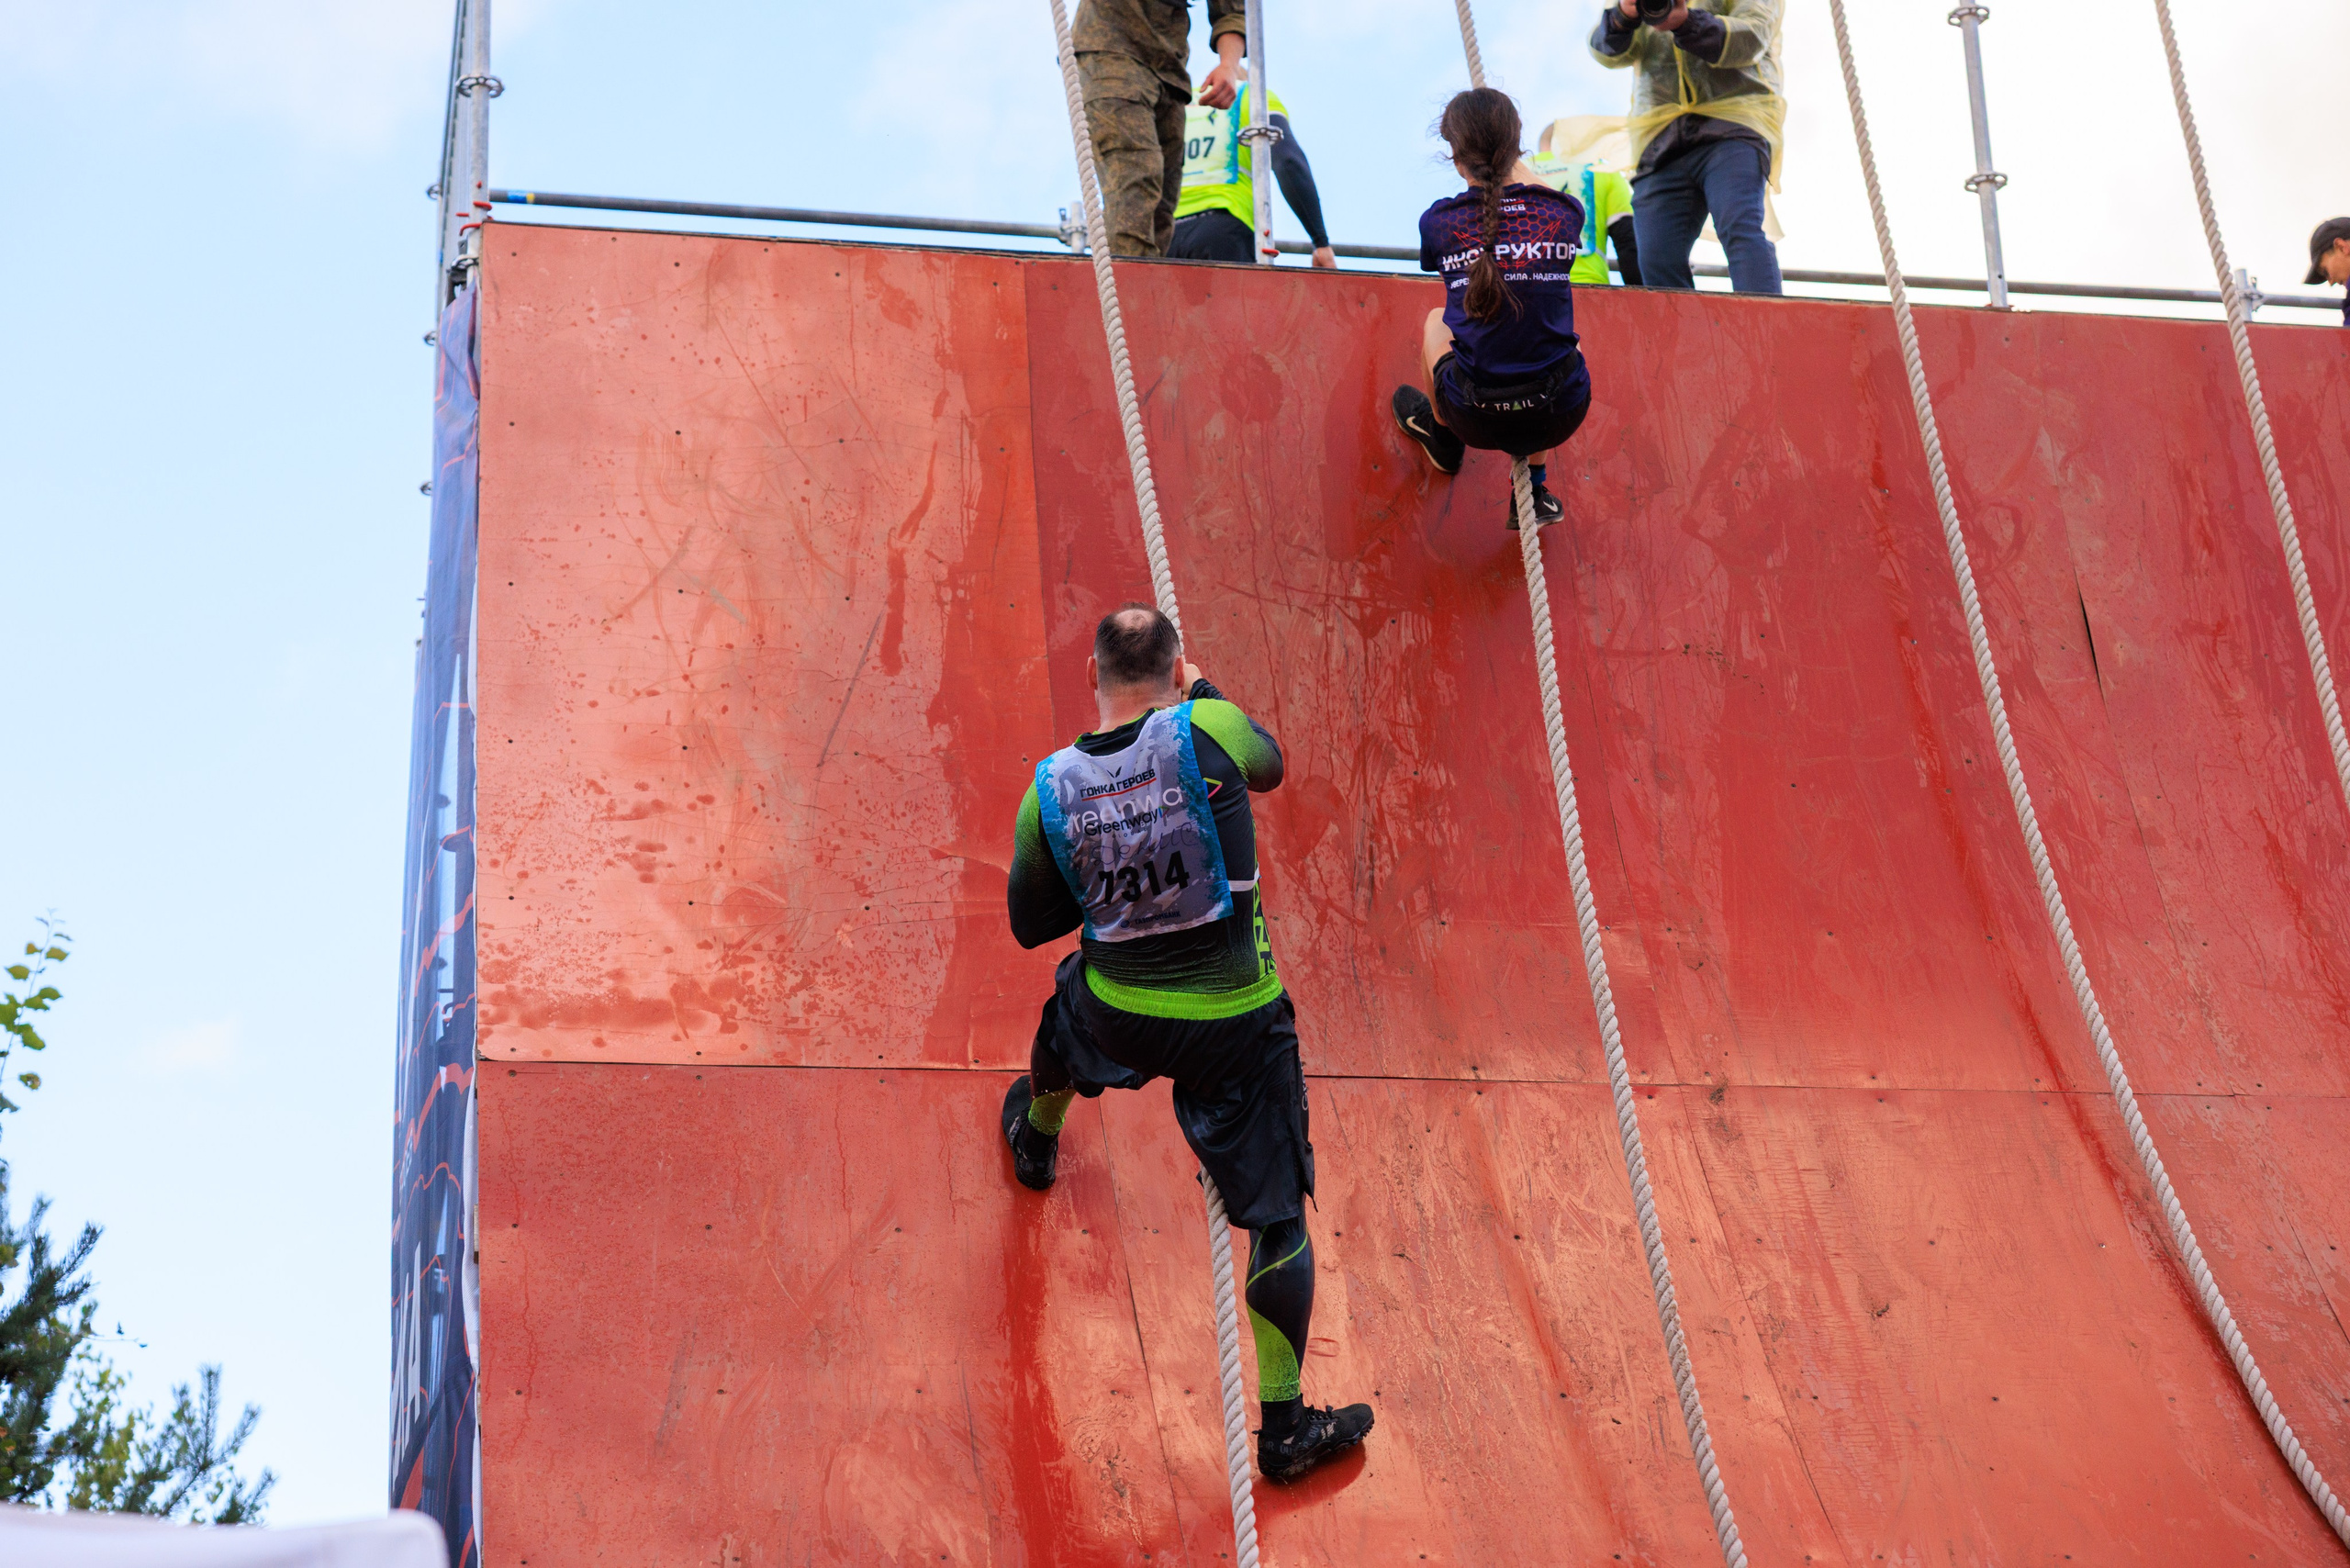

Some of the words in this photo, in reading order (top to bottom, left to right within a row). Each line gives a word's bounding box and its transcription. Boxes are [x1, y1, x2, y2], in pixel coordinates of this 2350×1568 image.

[1183, 136, 1215, 162] 07
[1442, 241, 1576, 272] ИНСРУКТОР
[1494, 399, 1535, 411] TRAIL
[1080, 782, 1116, 798] ГОНКА
[1115, 768, 1156, 792] ГЕРОЕВ
[1084, 808, 1158, 836] Greenway
[1098, 850, 1191, 904] 7314
[1135, 911, 1181, 925] ГАЗПРОМБАНК
